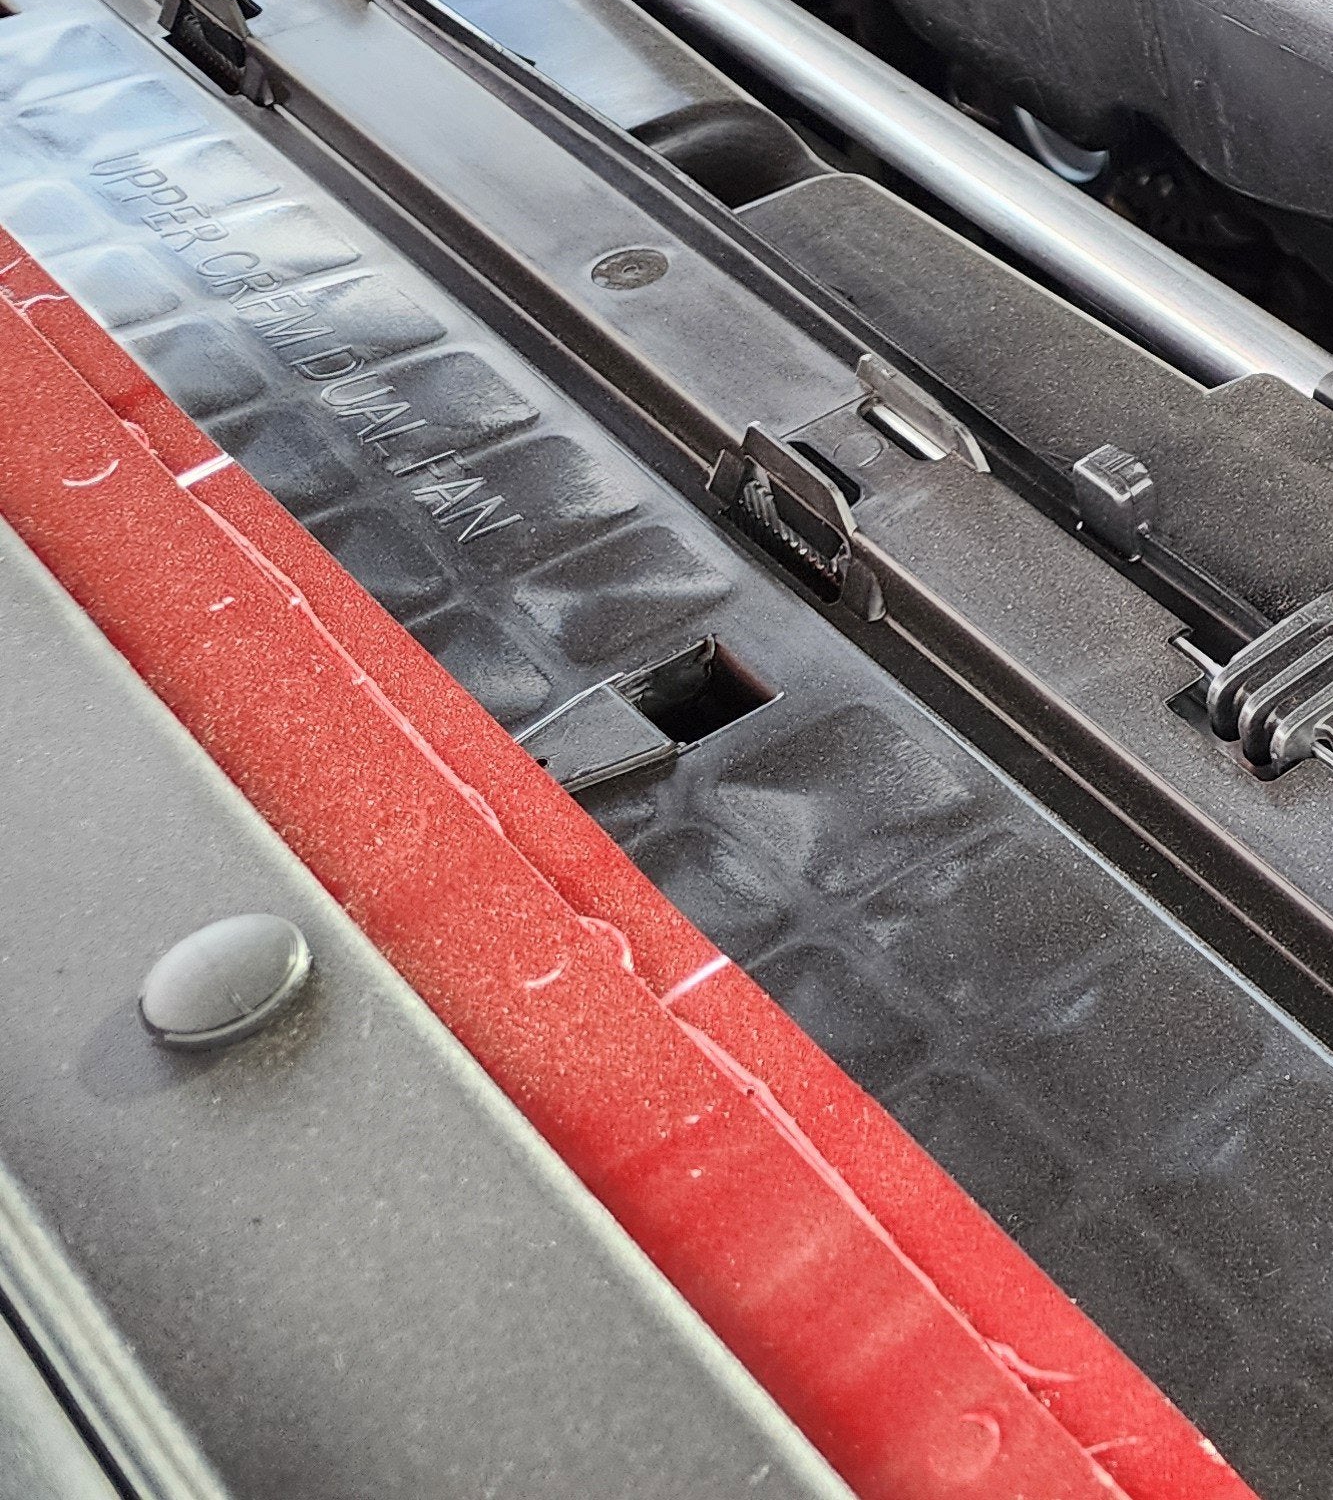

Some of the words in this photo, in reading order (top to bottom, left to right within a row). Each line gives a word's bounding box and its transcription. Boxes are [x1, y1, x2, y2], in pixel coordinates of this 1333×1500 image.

[90, 150, 232, 255] UPPER
[290, 344, 427, 458] DUAL
[393, 448, 525, 545] FAN
